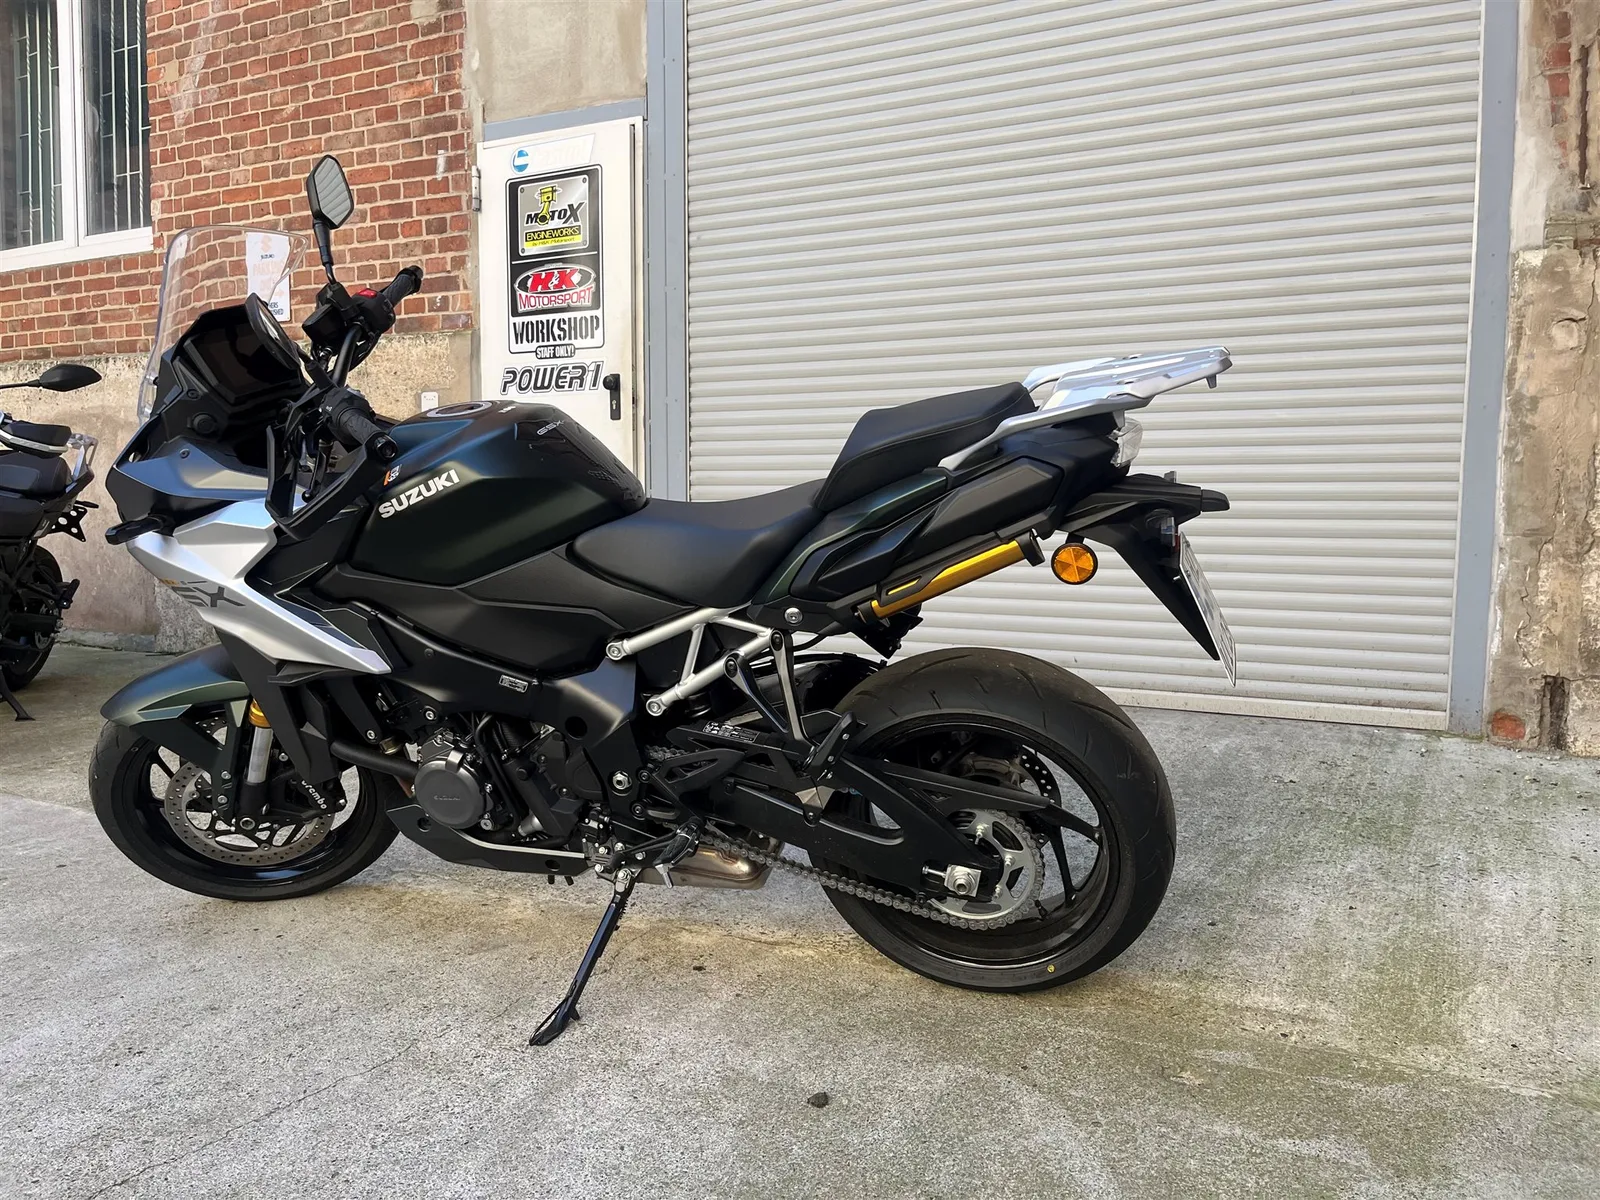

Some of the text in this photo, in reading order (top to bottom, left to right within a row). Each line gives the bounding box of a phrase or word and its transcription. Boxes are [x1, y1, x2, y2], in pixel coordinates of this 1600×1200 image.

[526, 227, 579, 241] ENGINEWORKS
[518, 286, 594, 310] MOTORSPORT
[512, 315, 600, 345] WORKSHOP
[536, 344, 575, 358] STAFF ONLY!
[501, 362, 603, 394] POWER1
[378, 469, 460, 519] SUZUKI
